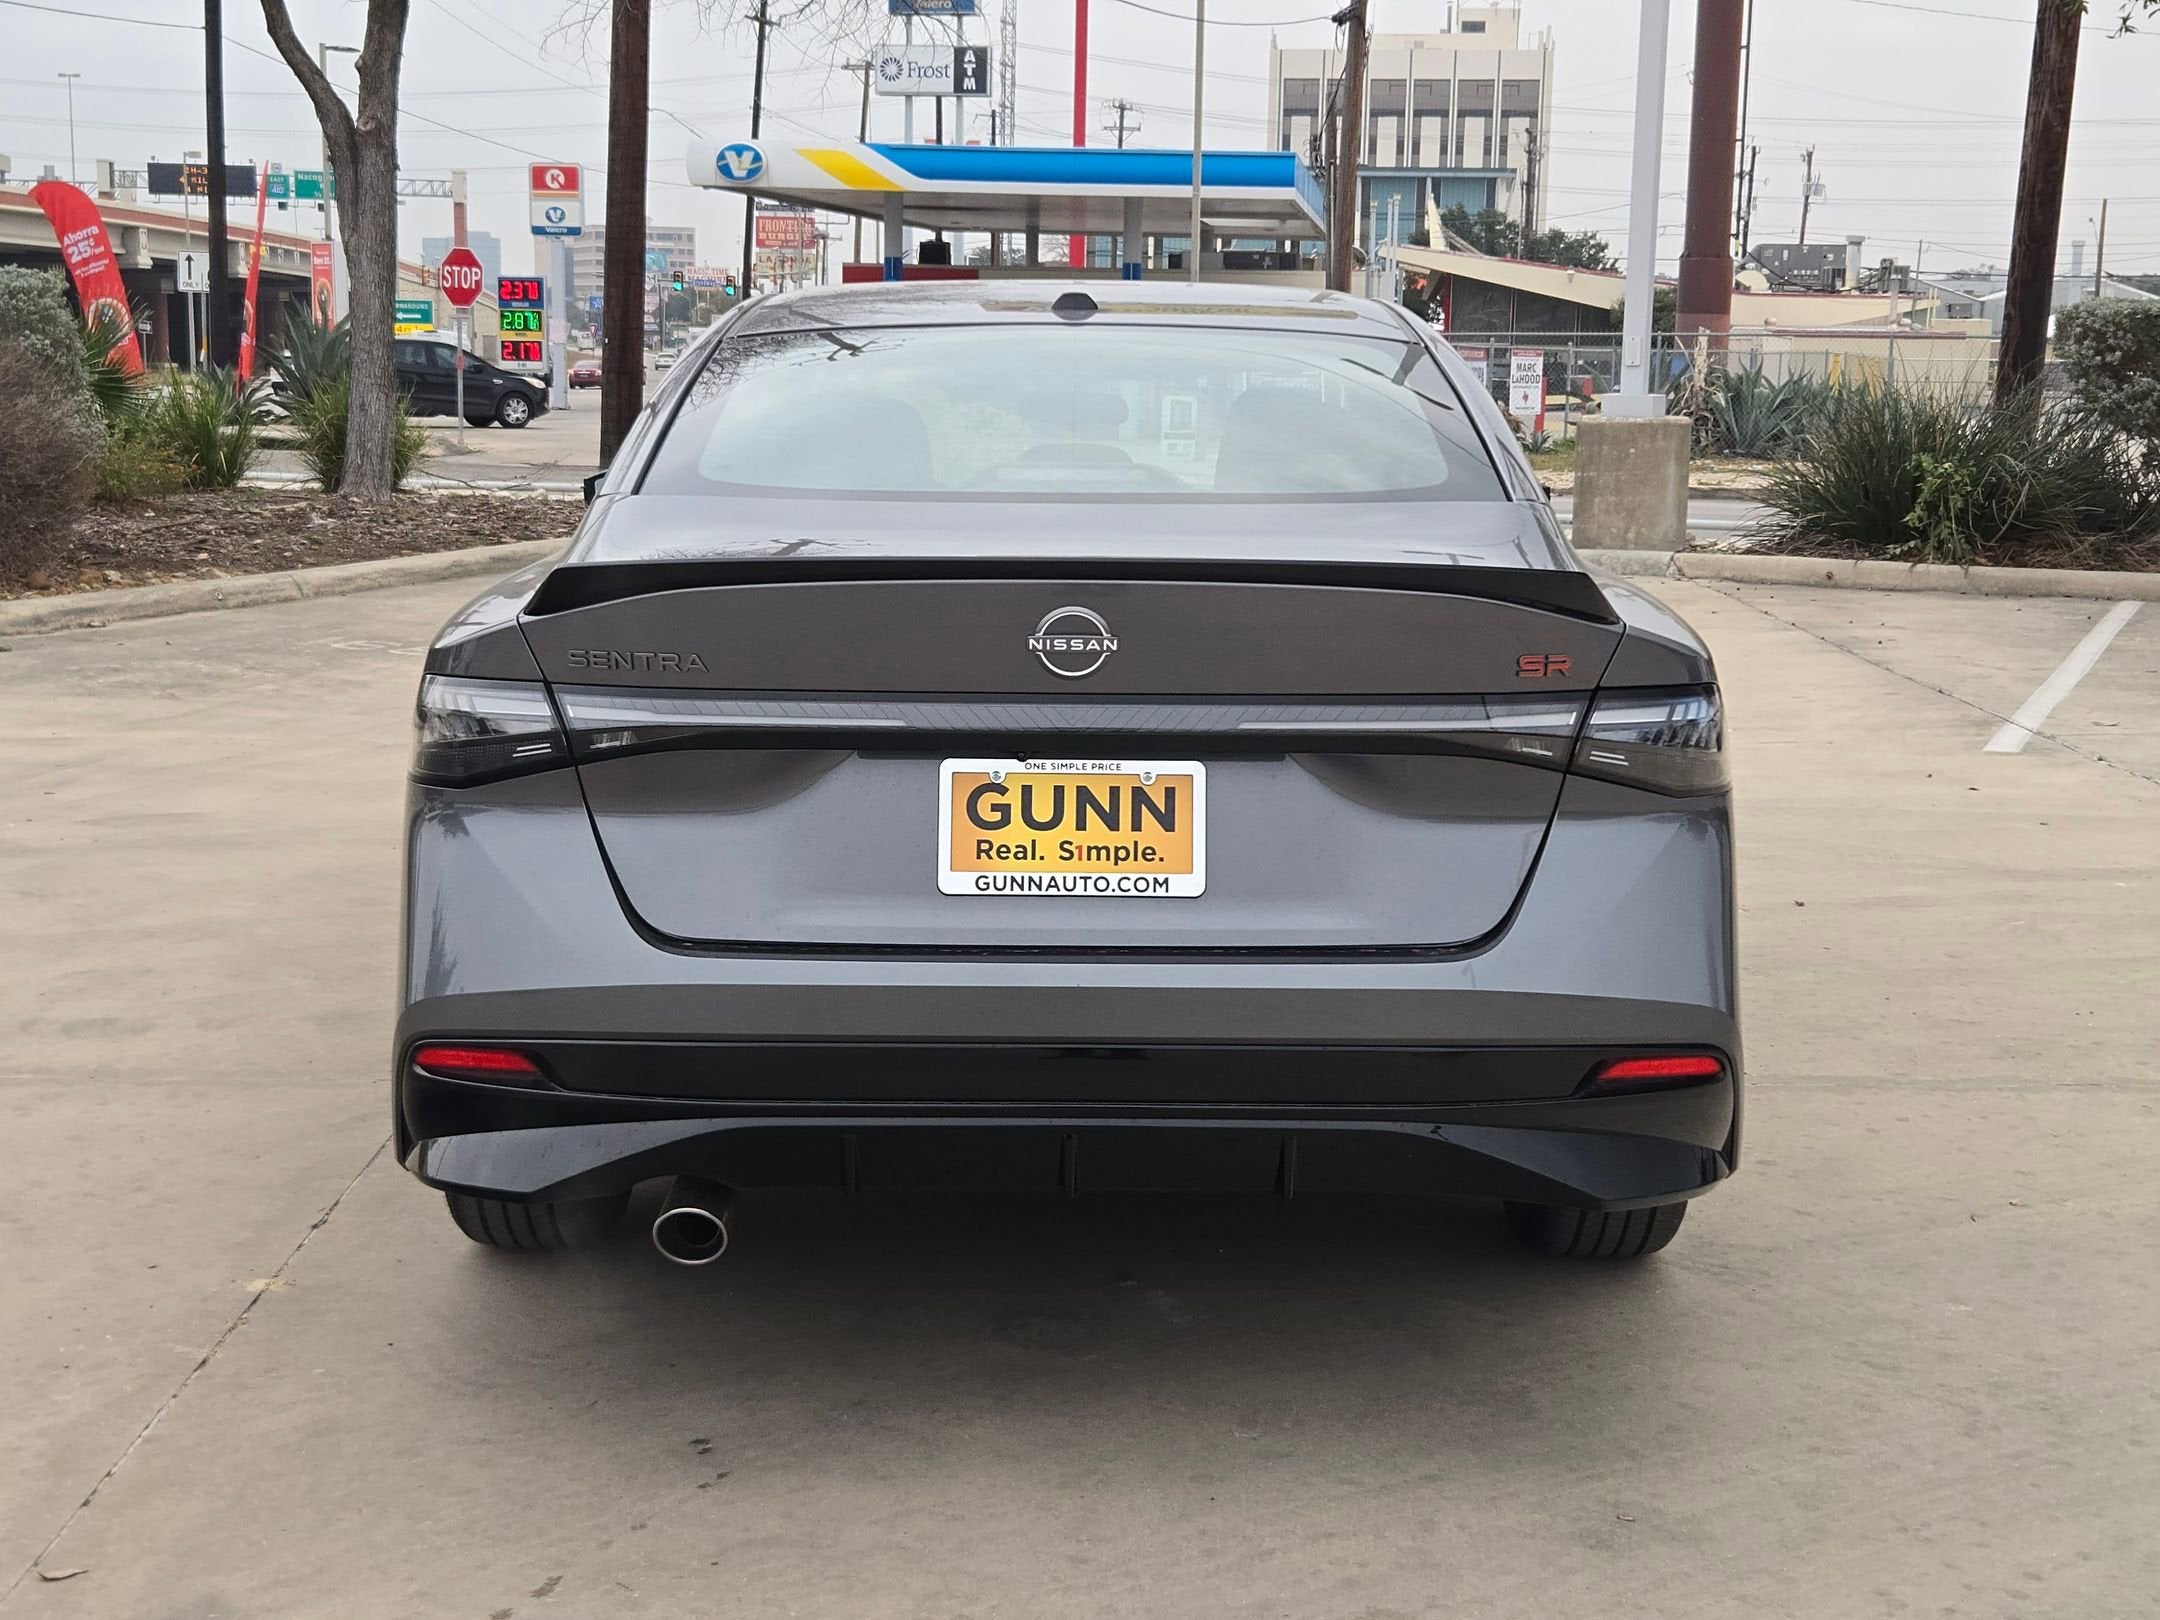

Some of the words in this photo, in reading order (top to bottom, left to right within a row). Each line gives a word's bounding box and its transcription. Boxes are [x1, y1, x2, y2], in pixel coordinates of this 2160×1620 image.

[907, 61, 951, 79] Frost
[963, 50, 976, 91] ATM
[63, 225, 99, 247] Ahorra
[545, 226, 568, 234] Valero
[443, 265, 481, 289] STOP
[1516, 362, 1537, 373] MARC
[1029, 638, 1118, 651] NISSAN
[567, 648, 710, 673] SENTRA
[1516, 653, 1572, 678] SR
[1024, 762, 1047, 771] ONE
[1050, 762, 1088, 772] SIMPLE
[1091, 763, 1122, 772] PRICE
[966, 782, 1176, 833] GUNN
[975, 839, 1045, 861] Real.
[974, 875, 1169, 893] GUNNAUTO.COM
